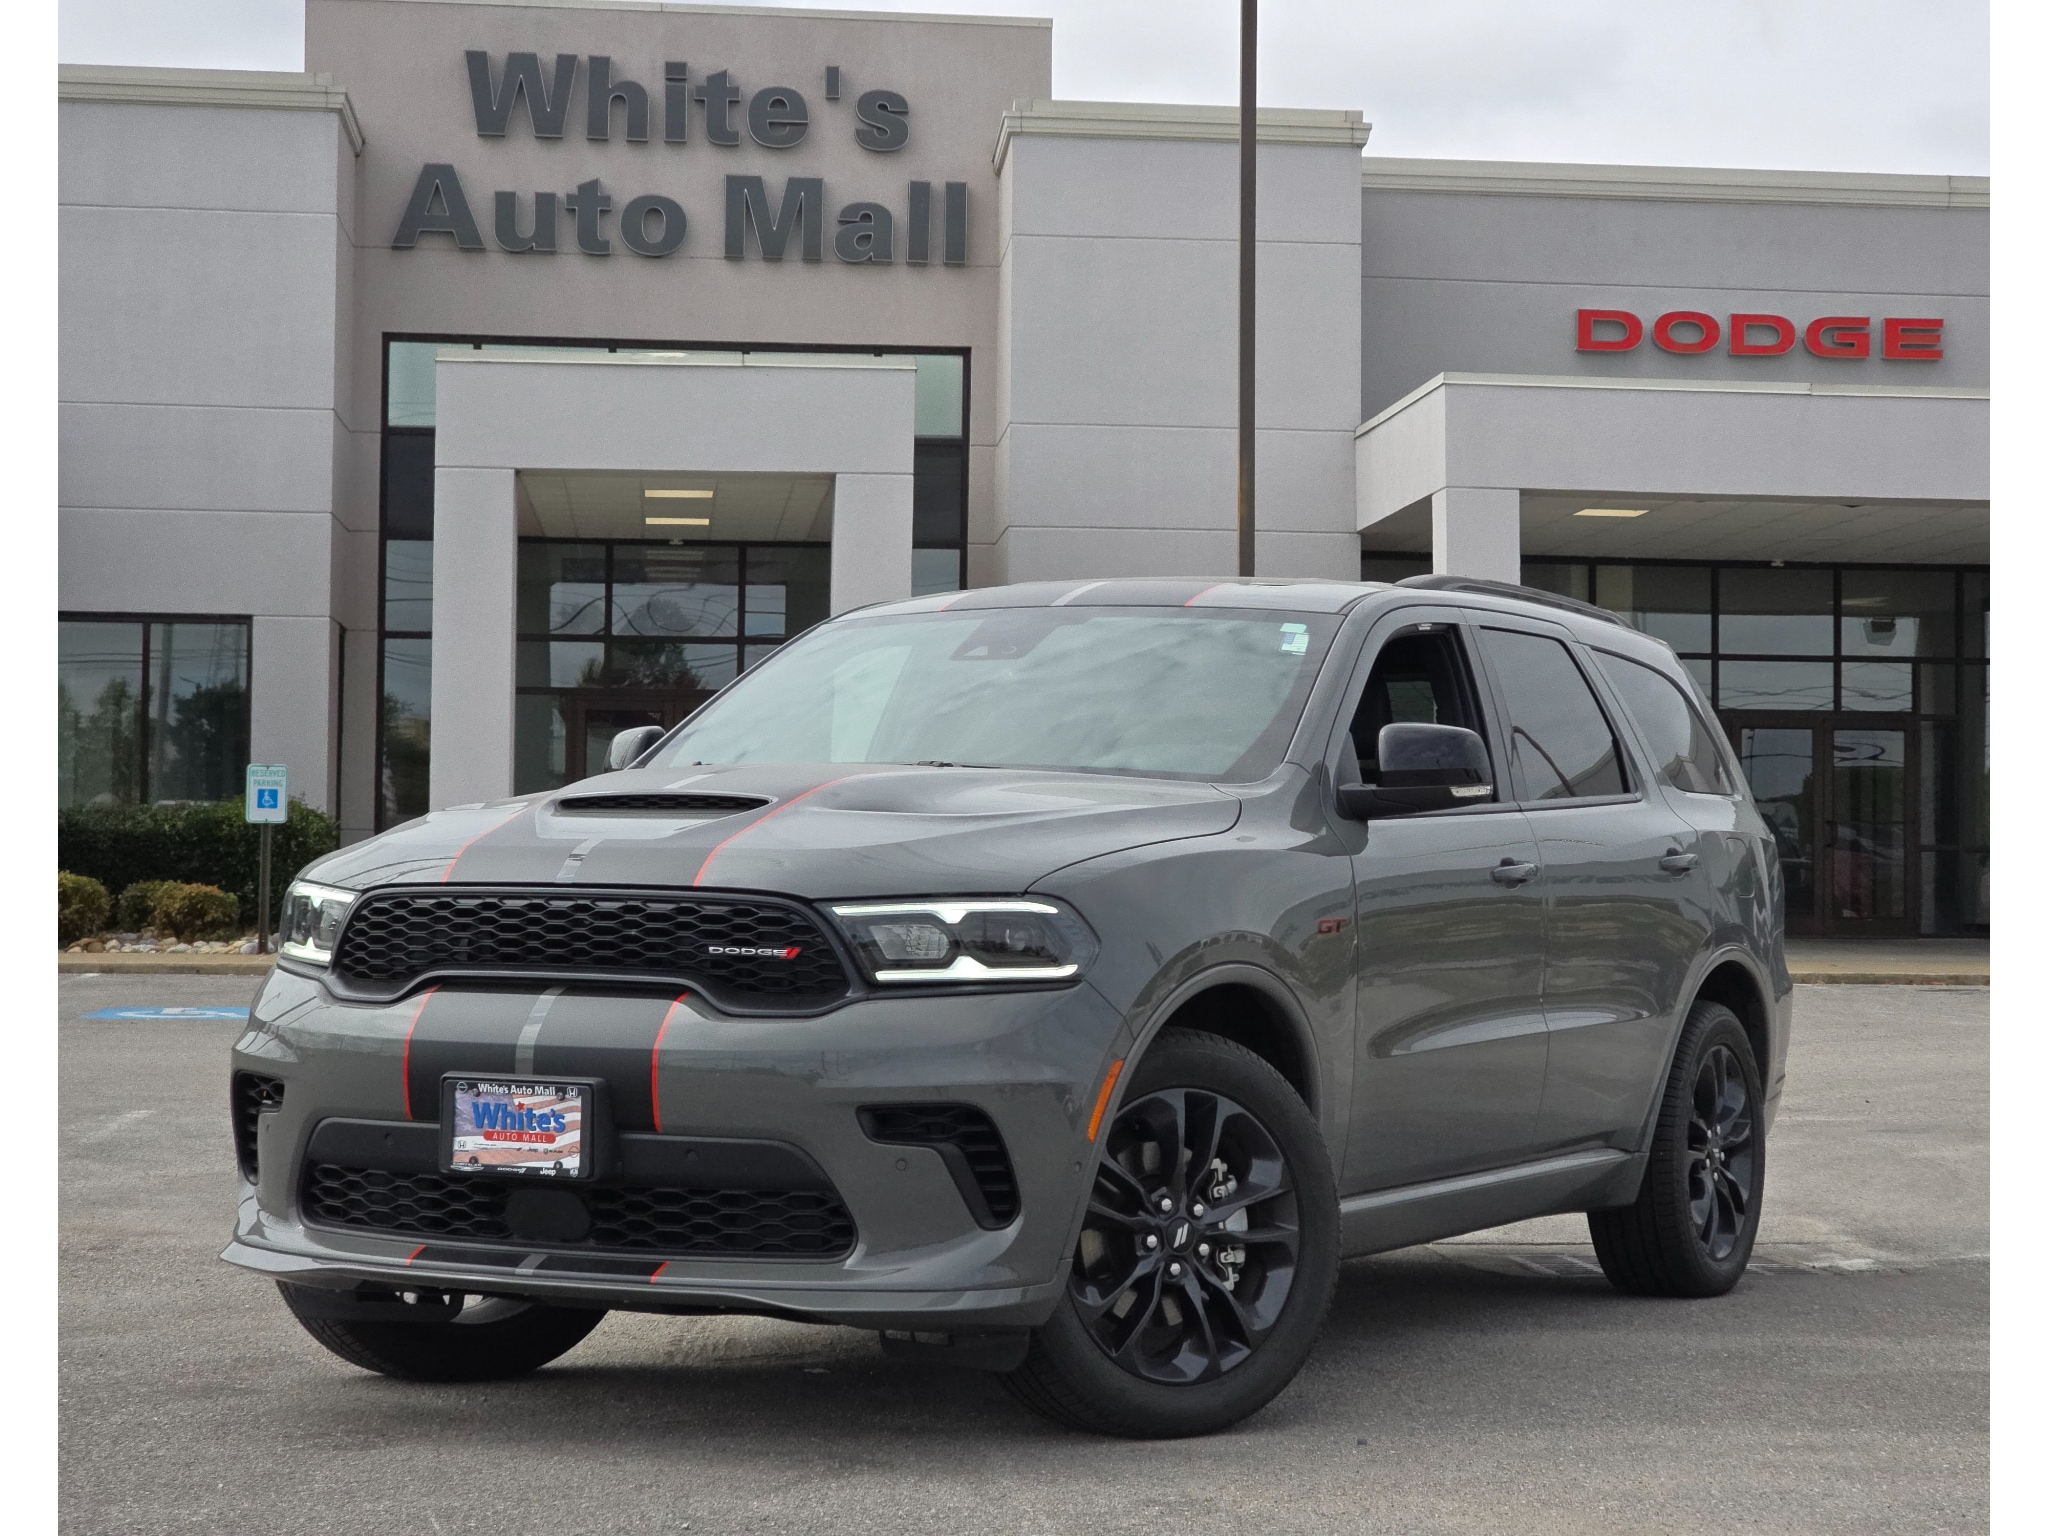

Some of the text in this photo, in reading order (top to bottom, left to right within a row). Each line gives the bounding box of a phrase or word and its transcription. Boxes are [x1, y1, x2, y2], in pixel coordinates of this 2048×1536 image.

[464, 50, 910, 151] White's
[391, 163, 967, 265] Auto Mall
[1576, 309, 1944, 360] DODGE
[1318, 918, 1347, 935] GT
[709, 946, 788, 957] DODGE
[477, 1083, 556, 1096] White's Auto Mall
[472, 1101, 566, 1133] White's
[493, 1132, 547, 1143] AUTO MALL
[540, 1168, 556, 1177] Jeep
